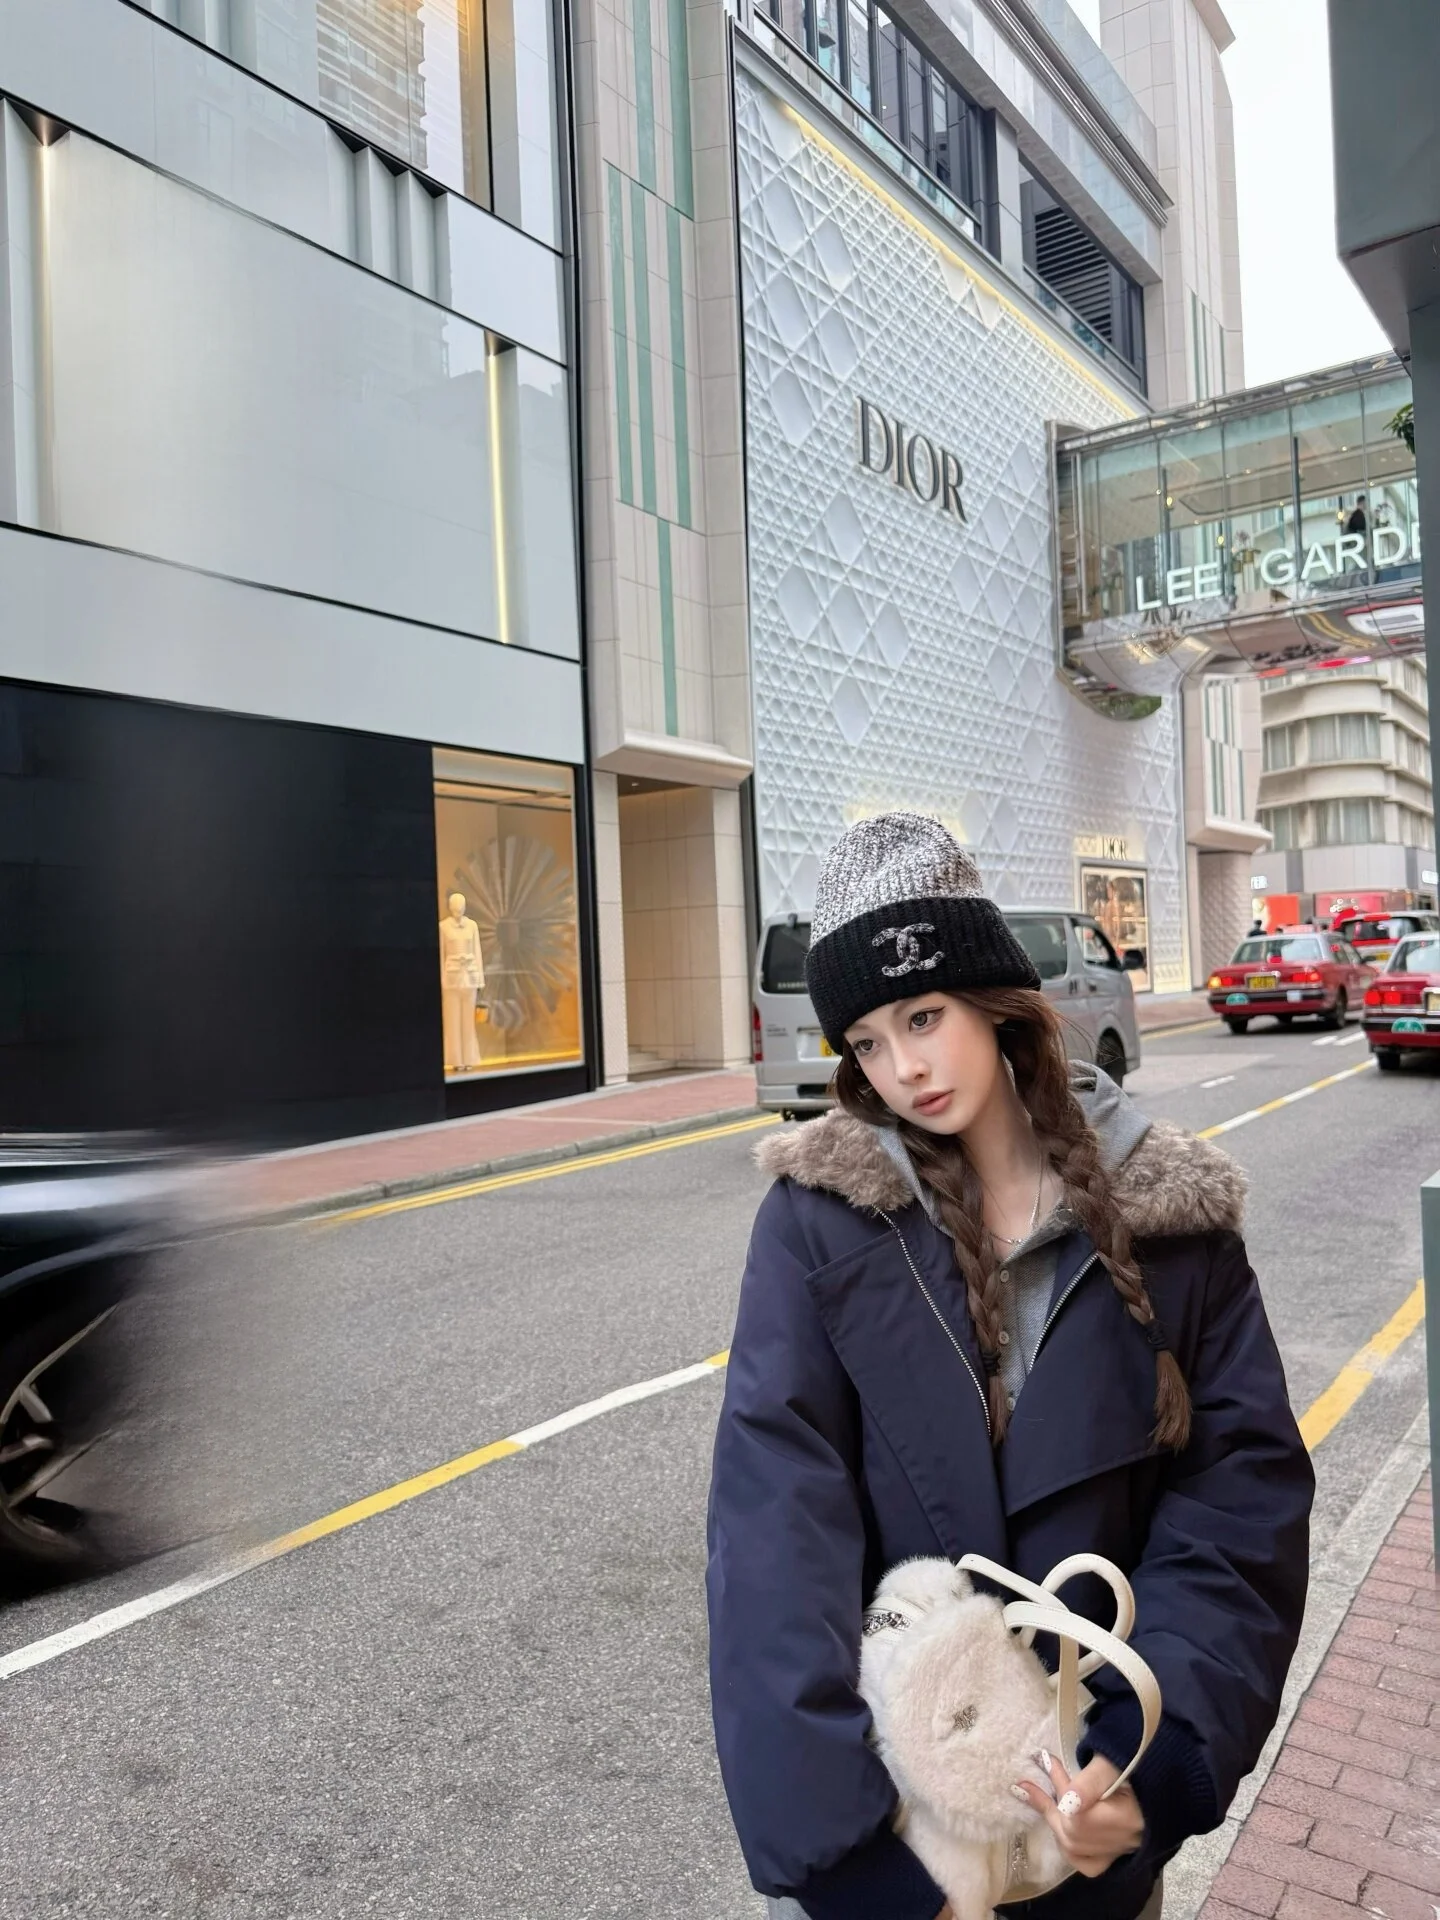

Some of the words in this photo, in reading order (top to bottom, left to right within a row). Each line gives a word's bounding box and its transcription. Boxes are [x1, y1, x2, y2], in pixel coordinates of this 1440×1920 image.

[856, 395, 968, 523] DIOR
[1136, 561, 1223, 611] LEE
[1101, 836, 1128, 862] DIOR
